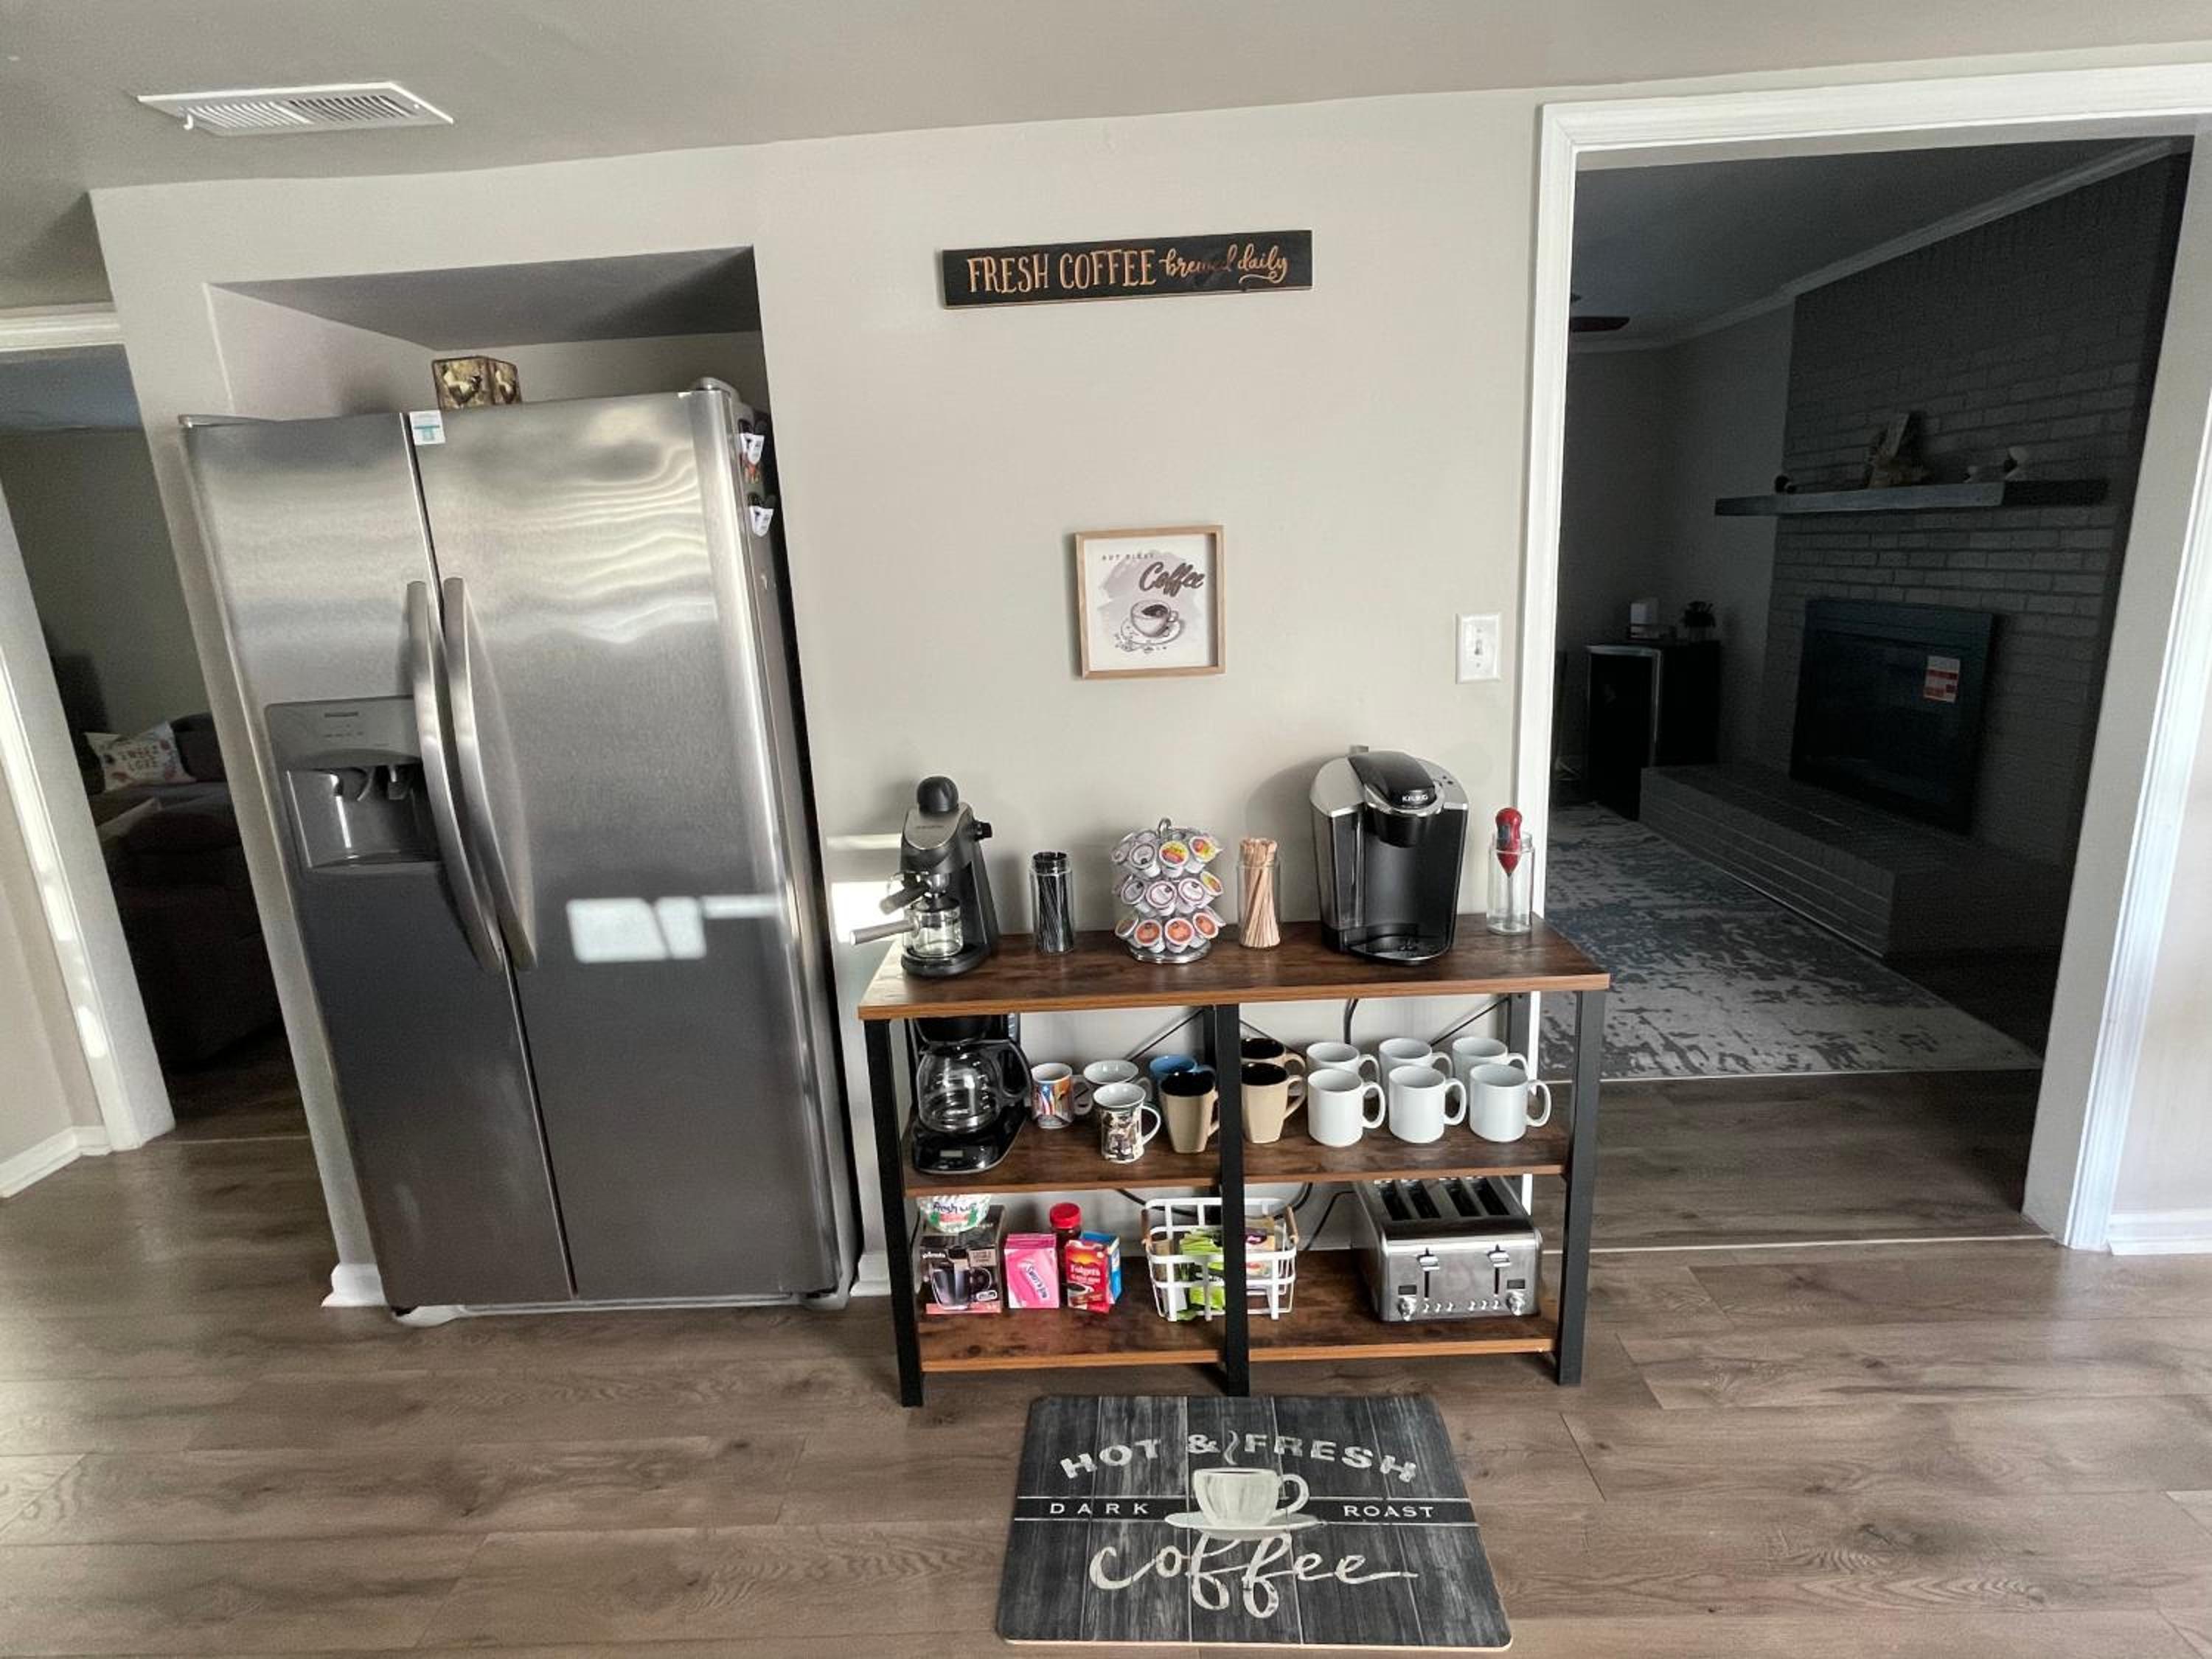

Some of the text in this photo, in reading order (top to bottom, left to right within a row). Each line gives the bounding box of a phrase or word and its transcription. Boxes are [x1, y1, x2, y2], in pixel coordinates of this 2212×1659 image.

[967, 253, 1050, 293] FRESH
[1059, 248, 1157, 290] COFFEE
[1236, 243, 1290, 284] daily
[1138, 561, 1206, 597] Coffee
[1059, 1433, 1417, 1484] HOT & FRESH
[1049, 1501, 1436, 1519] DARK ROAST
